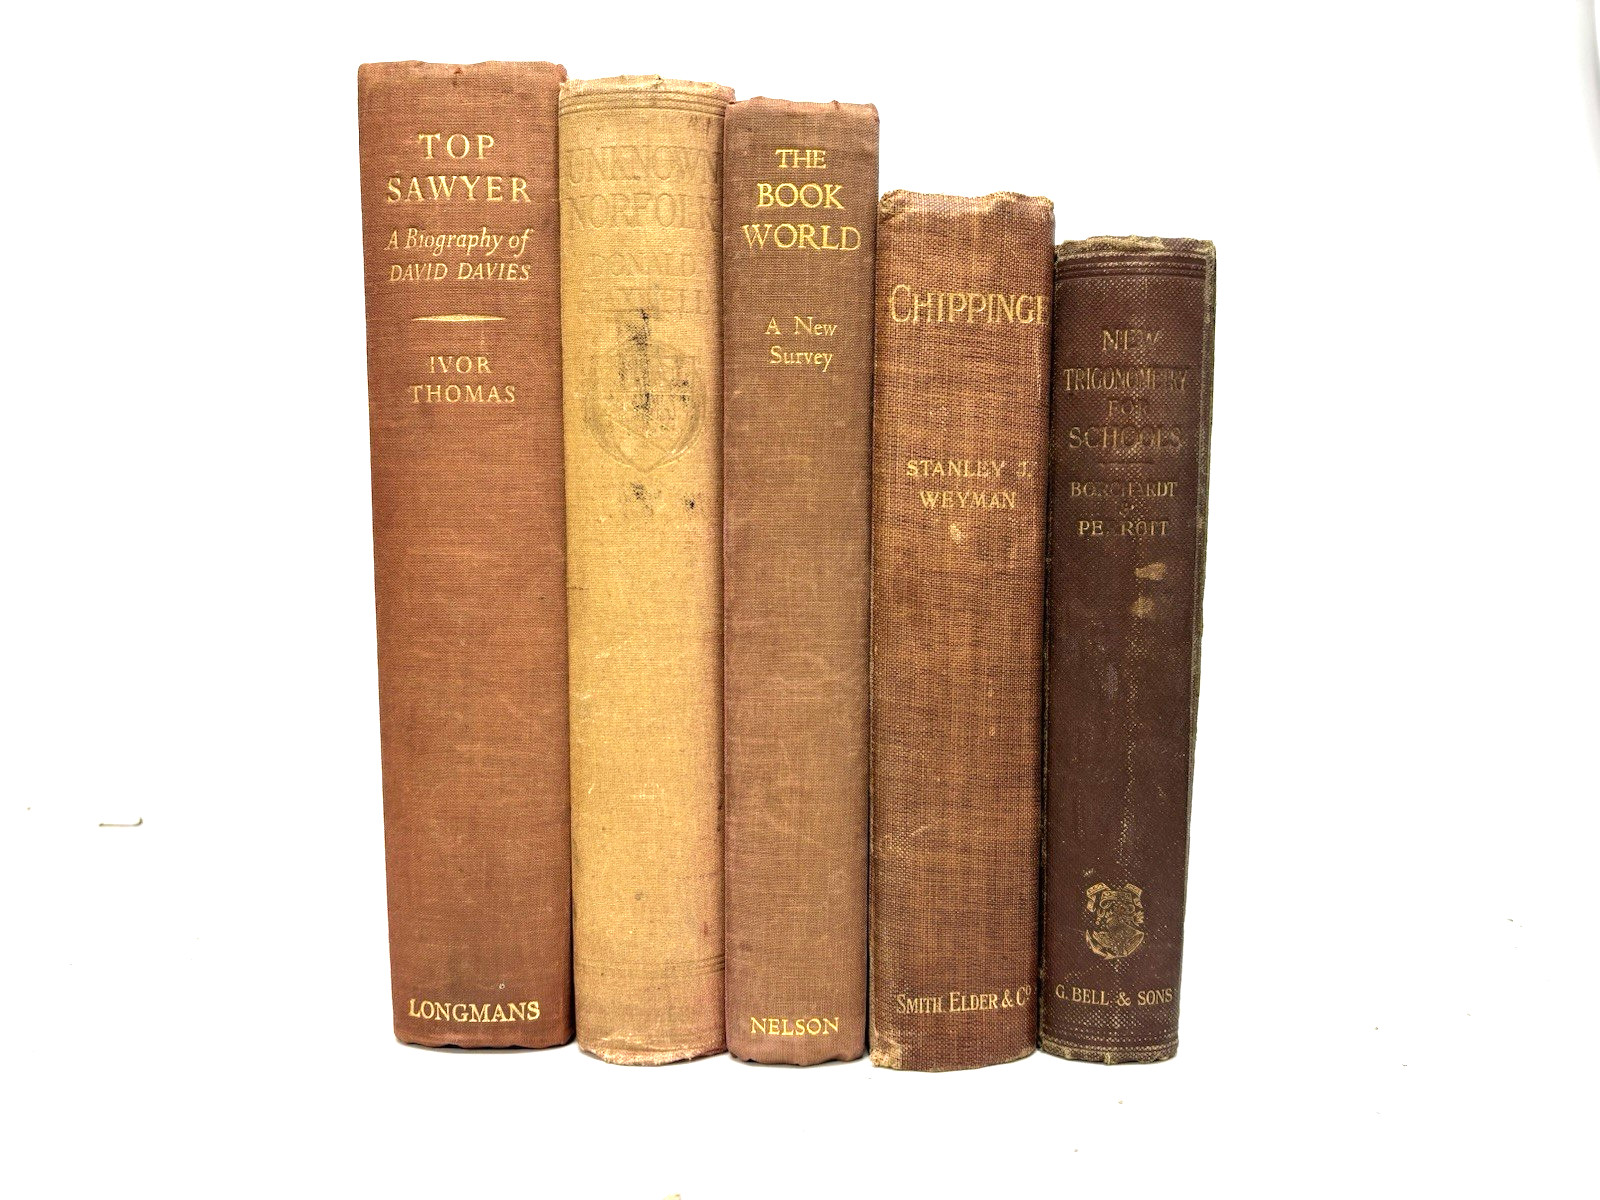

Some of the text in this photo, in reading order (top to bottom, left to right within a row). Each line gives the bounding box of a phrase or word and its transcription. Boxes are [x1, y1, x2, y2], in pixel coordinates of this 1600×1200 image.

[418, 133, 495, 159] TOP
[775, 149, 827, 169] THE
[386, 175, 530, 203] SAWYER
[757, 183, 844, 208] BOOK
[385, 227, 533, 257] A Biography of
[742, 223, 862, 250] WORLD
[390, 263, 531, 281] DAVID DAVIES
[765, 316, 838, 336] A New
[429, 356, 492, 374] IVOR
[770, 346, 833, 372] Survey
[410, 385, 516, 403] THOMAS
[1068, 426, 1183, 450] SCHOOLS
[906, 459, 1005, 478] STANLEY
[920, 490, 1016, 509] WEYMAN
[897, 994, 943, 1014] SMITH
[950, 991, 998, 1012] ELDER
[1001, 989, 1015, 1008] &
[1055, 984, 1173, 1006] G. BELL & SONS
[408, 999, 541, 1023] LONGMANS
[750, 1016, 839, 1036] NELSON
